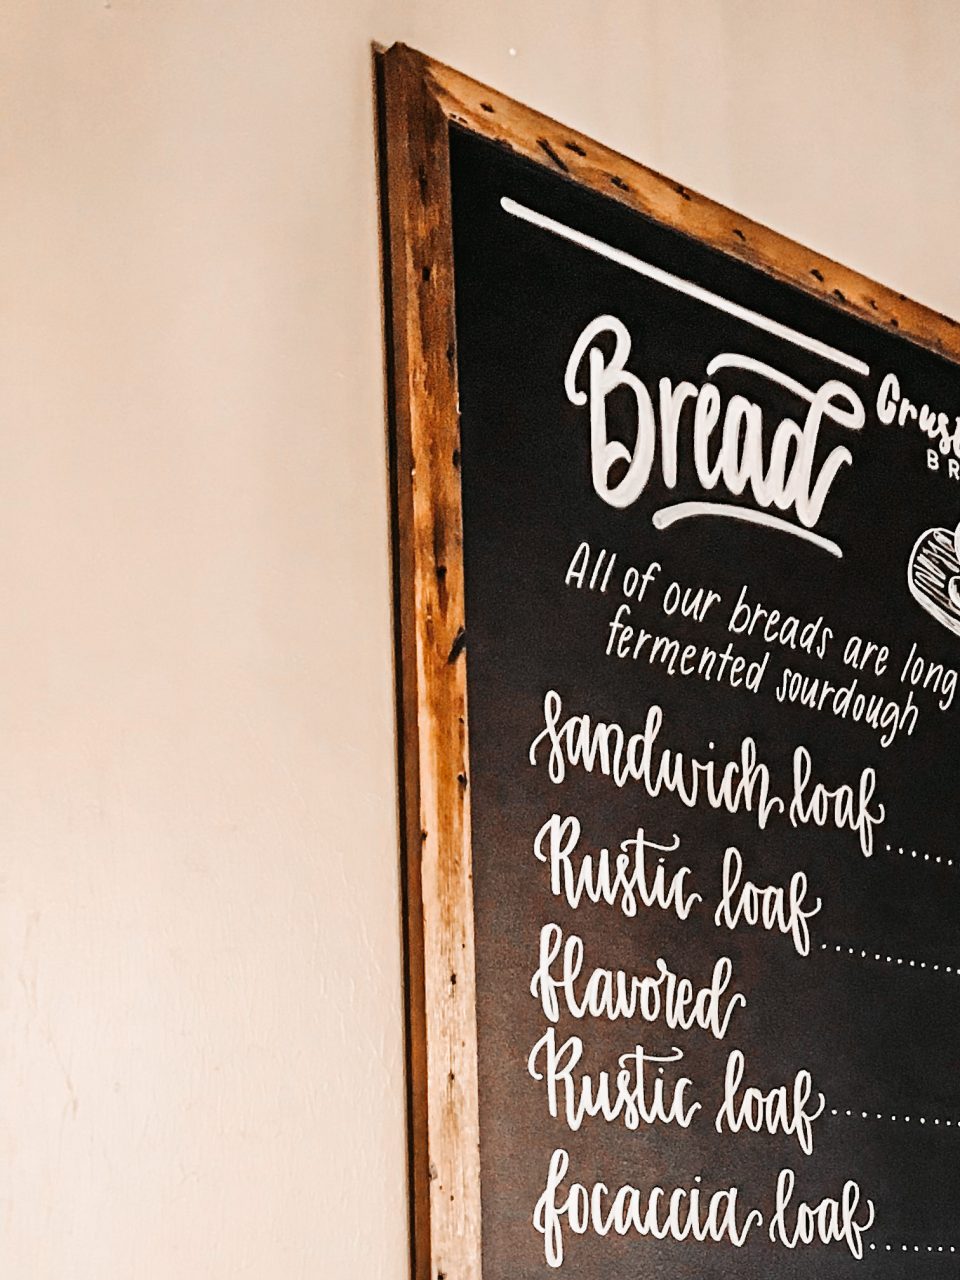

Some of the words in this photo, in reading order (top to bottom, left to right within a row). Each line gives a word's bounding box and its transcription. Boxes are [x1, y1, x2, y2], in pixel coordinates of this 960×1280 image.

[565, 315, 865, 527] Bread
[565, 542, 616, 593] All
[623, 562, 661, 601] of
[663, 582, 721, 622] our
[728, 585, 833, 659] breads
[844, 637, 889, 676] are
[901, 643, 957, 710] long
[606, 604, 769, 693] fermented
[776, 667, 919, 747] sourdough
[790, 746, 885, 857] loaf
[534, 814, 702, 920] Rustic
[715, 847, 822, 956] loaf
[527, 1027, 702, 1131] Rustic
[715, 1050, 825, 1155] loaf
[769, 1169, 875, 1259] loaf
